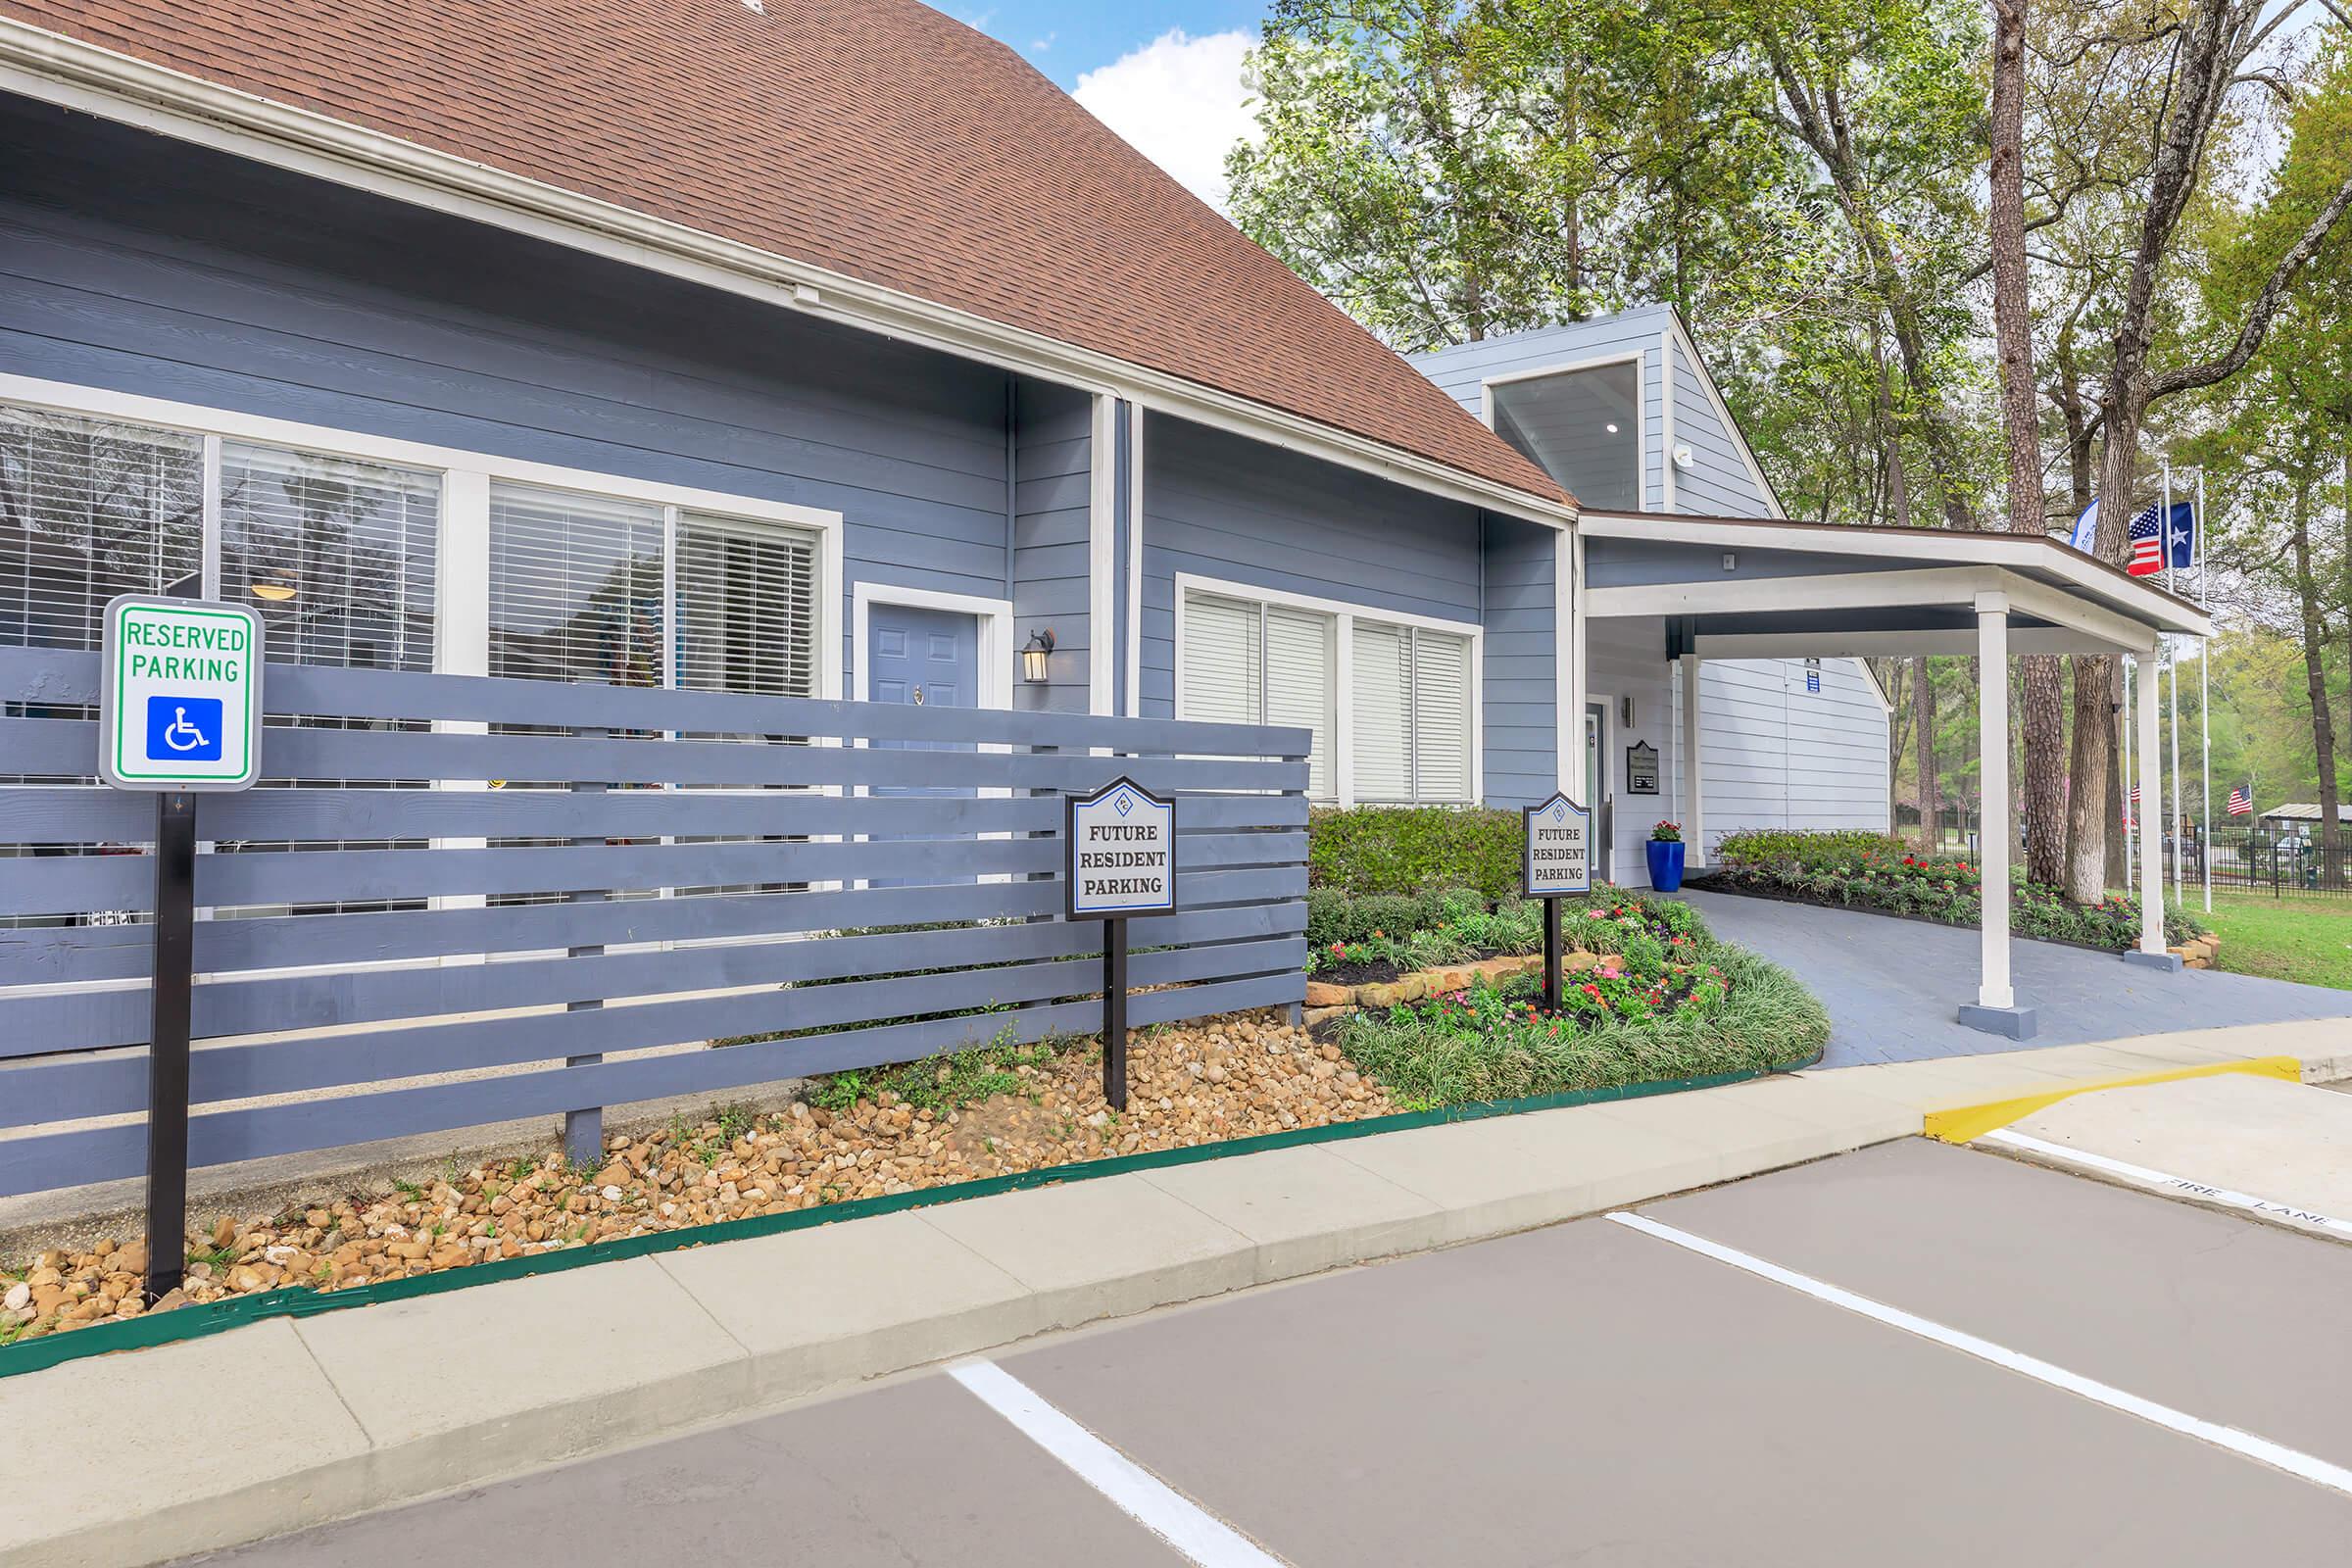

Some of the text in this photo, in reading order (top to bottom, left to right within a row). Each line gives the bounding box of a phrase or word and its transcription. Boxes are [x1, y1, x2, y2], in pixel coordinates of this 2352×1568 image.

[127, 622, 245, 651] RESERVED
[132, 655, 238, 683] PARKING
[1089, 826, 1157, 841] FUTURE
[1538, 829, 1580, 840] FUTURE
[1080, 852, 1166, 869] RESIDENT
[1533, 849, 1585, 860] RESIDENT
[1535, 868, 1583, 880] PARKING
[1084, 877, 1162, 896] PARKING
[2163, 1179, 2330, 1225] FIRE LANE
